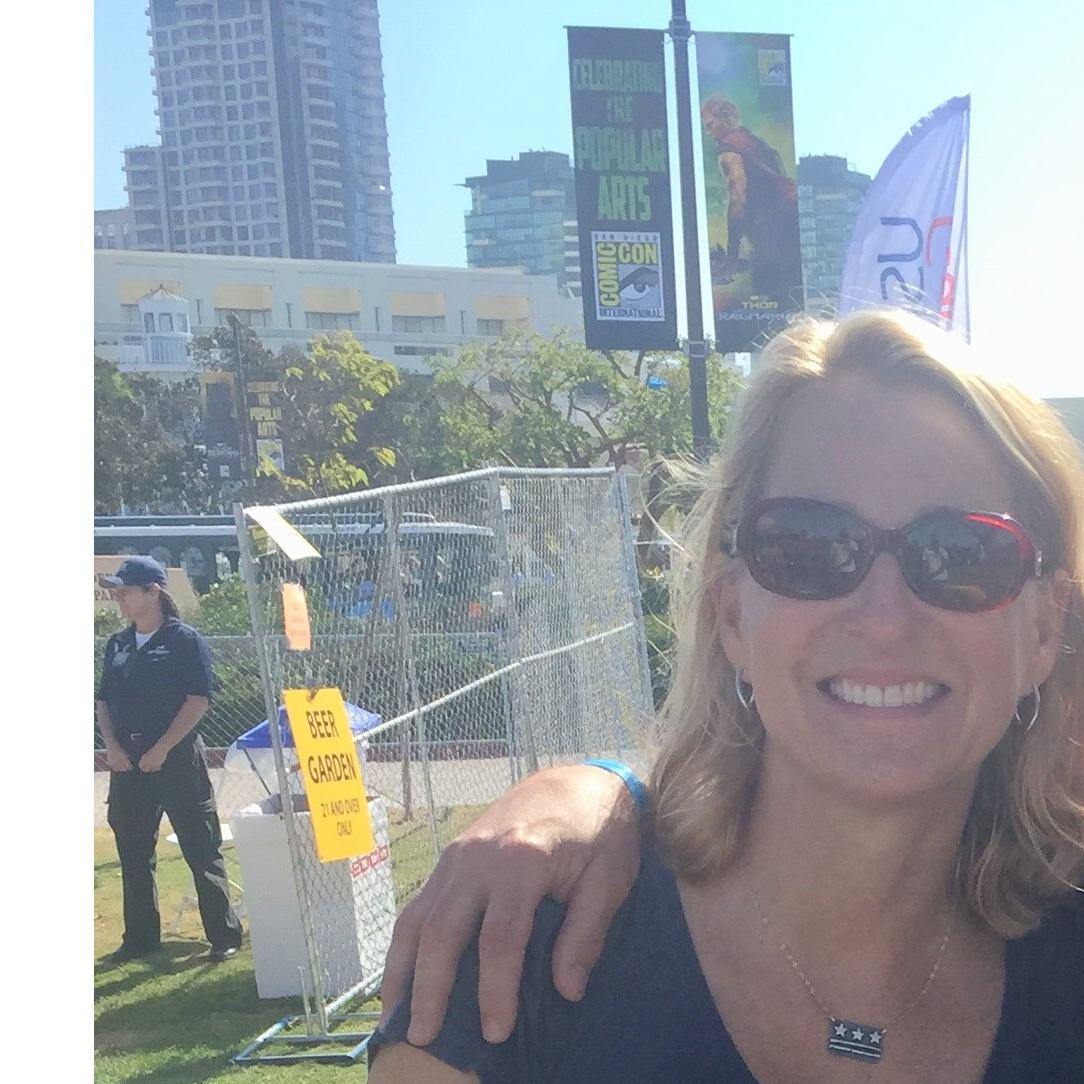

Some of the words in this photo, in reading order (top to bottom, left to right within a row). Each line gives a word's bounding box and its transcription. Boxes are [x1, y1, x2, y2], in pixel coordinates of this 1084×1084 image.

[576, 126, 666, 172] POPULAR
[597, 175, 652, 221] ARTS
[618, 242, 657, 264] CON
[596, 242, 621, 307] COMIC
[306, 710, 340, 739] BEER
[307, 753, 357, 784] GARDEN
[320, 802, 330, 818] 21
[331, 803, 344, 816] AND
[344, 798, 361, 814] OVER
[336, 820, 353, 836] ONLY
